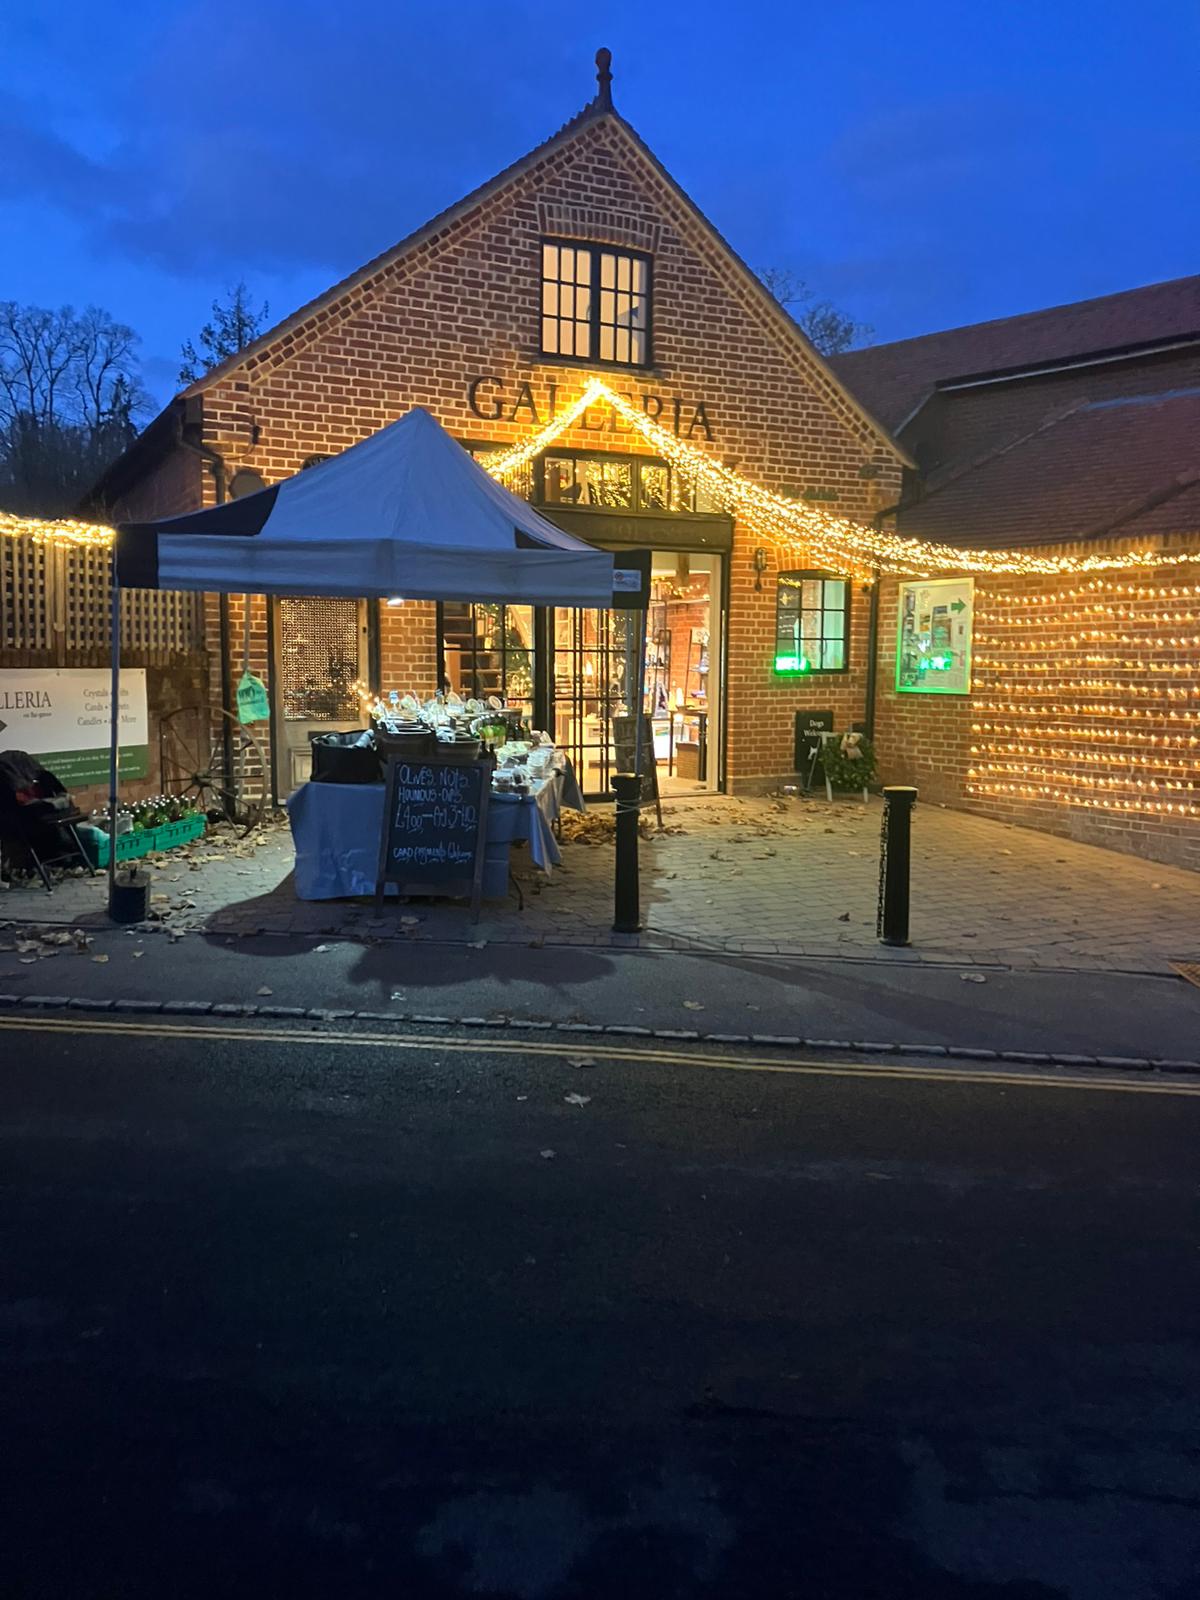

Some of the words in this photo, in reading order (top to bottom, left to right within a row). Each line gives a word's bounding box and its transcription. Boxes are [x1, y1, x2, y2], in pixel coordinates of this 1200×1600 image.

[468, 375, 717, 442] GALLERIA
[77, 716, 103, 726] Candles
[809, 719, 824, 728] Dogs
